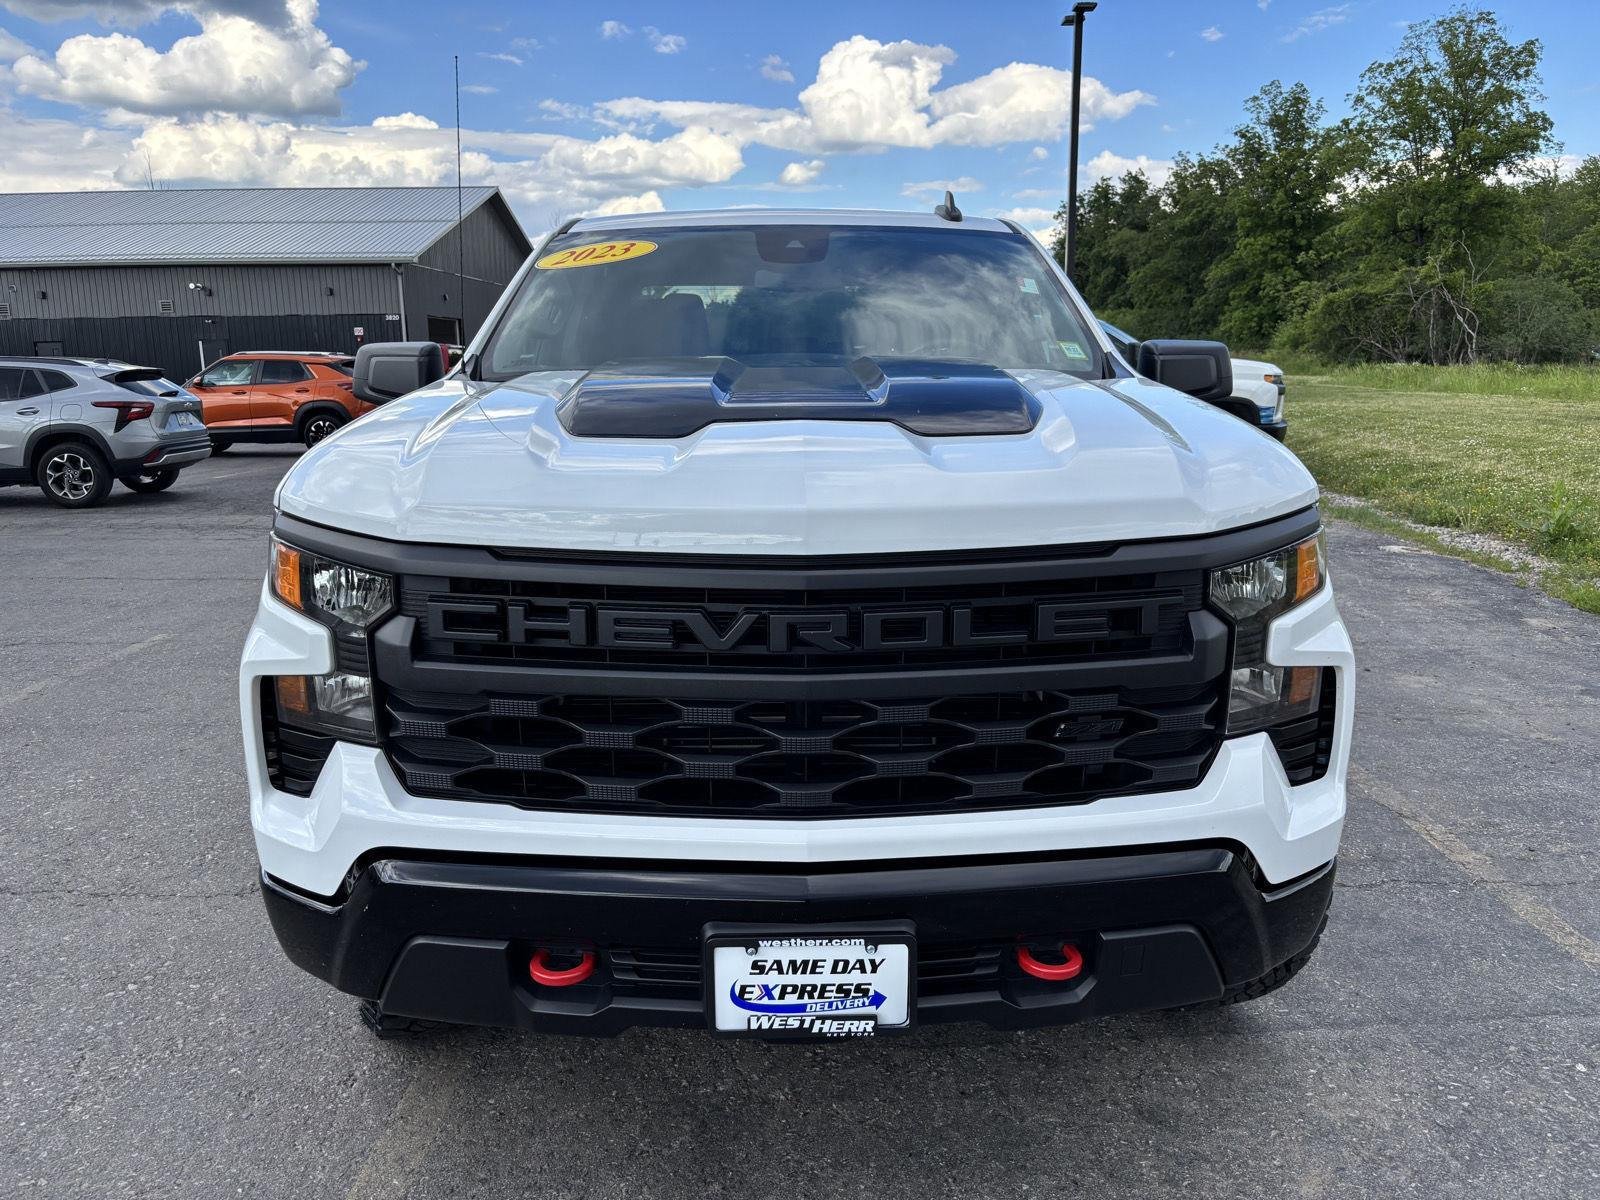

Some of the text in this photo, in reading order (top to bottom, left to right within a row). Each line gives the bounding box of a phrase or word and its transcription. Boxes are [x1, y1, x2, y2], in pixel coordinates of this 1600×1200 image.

[551, 242, 636, 266] 2023
[426, 593, 1184, 653] CHEVROLET
[758, 938, 864, 947] westherr.com
[749, 958, 886, 975] SAME DAY
[738, 982, 872, 1000] EXPRESS
[806, 997, 871, 1013] DELIVERY
